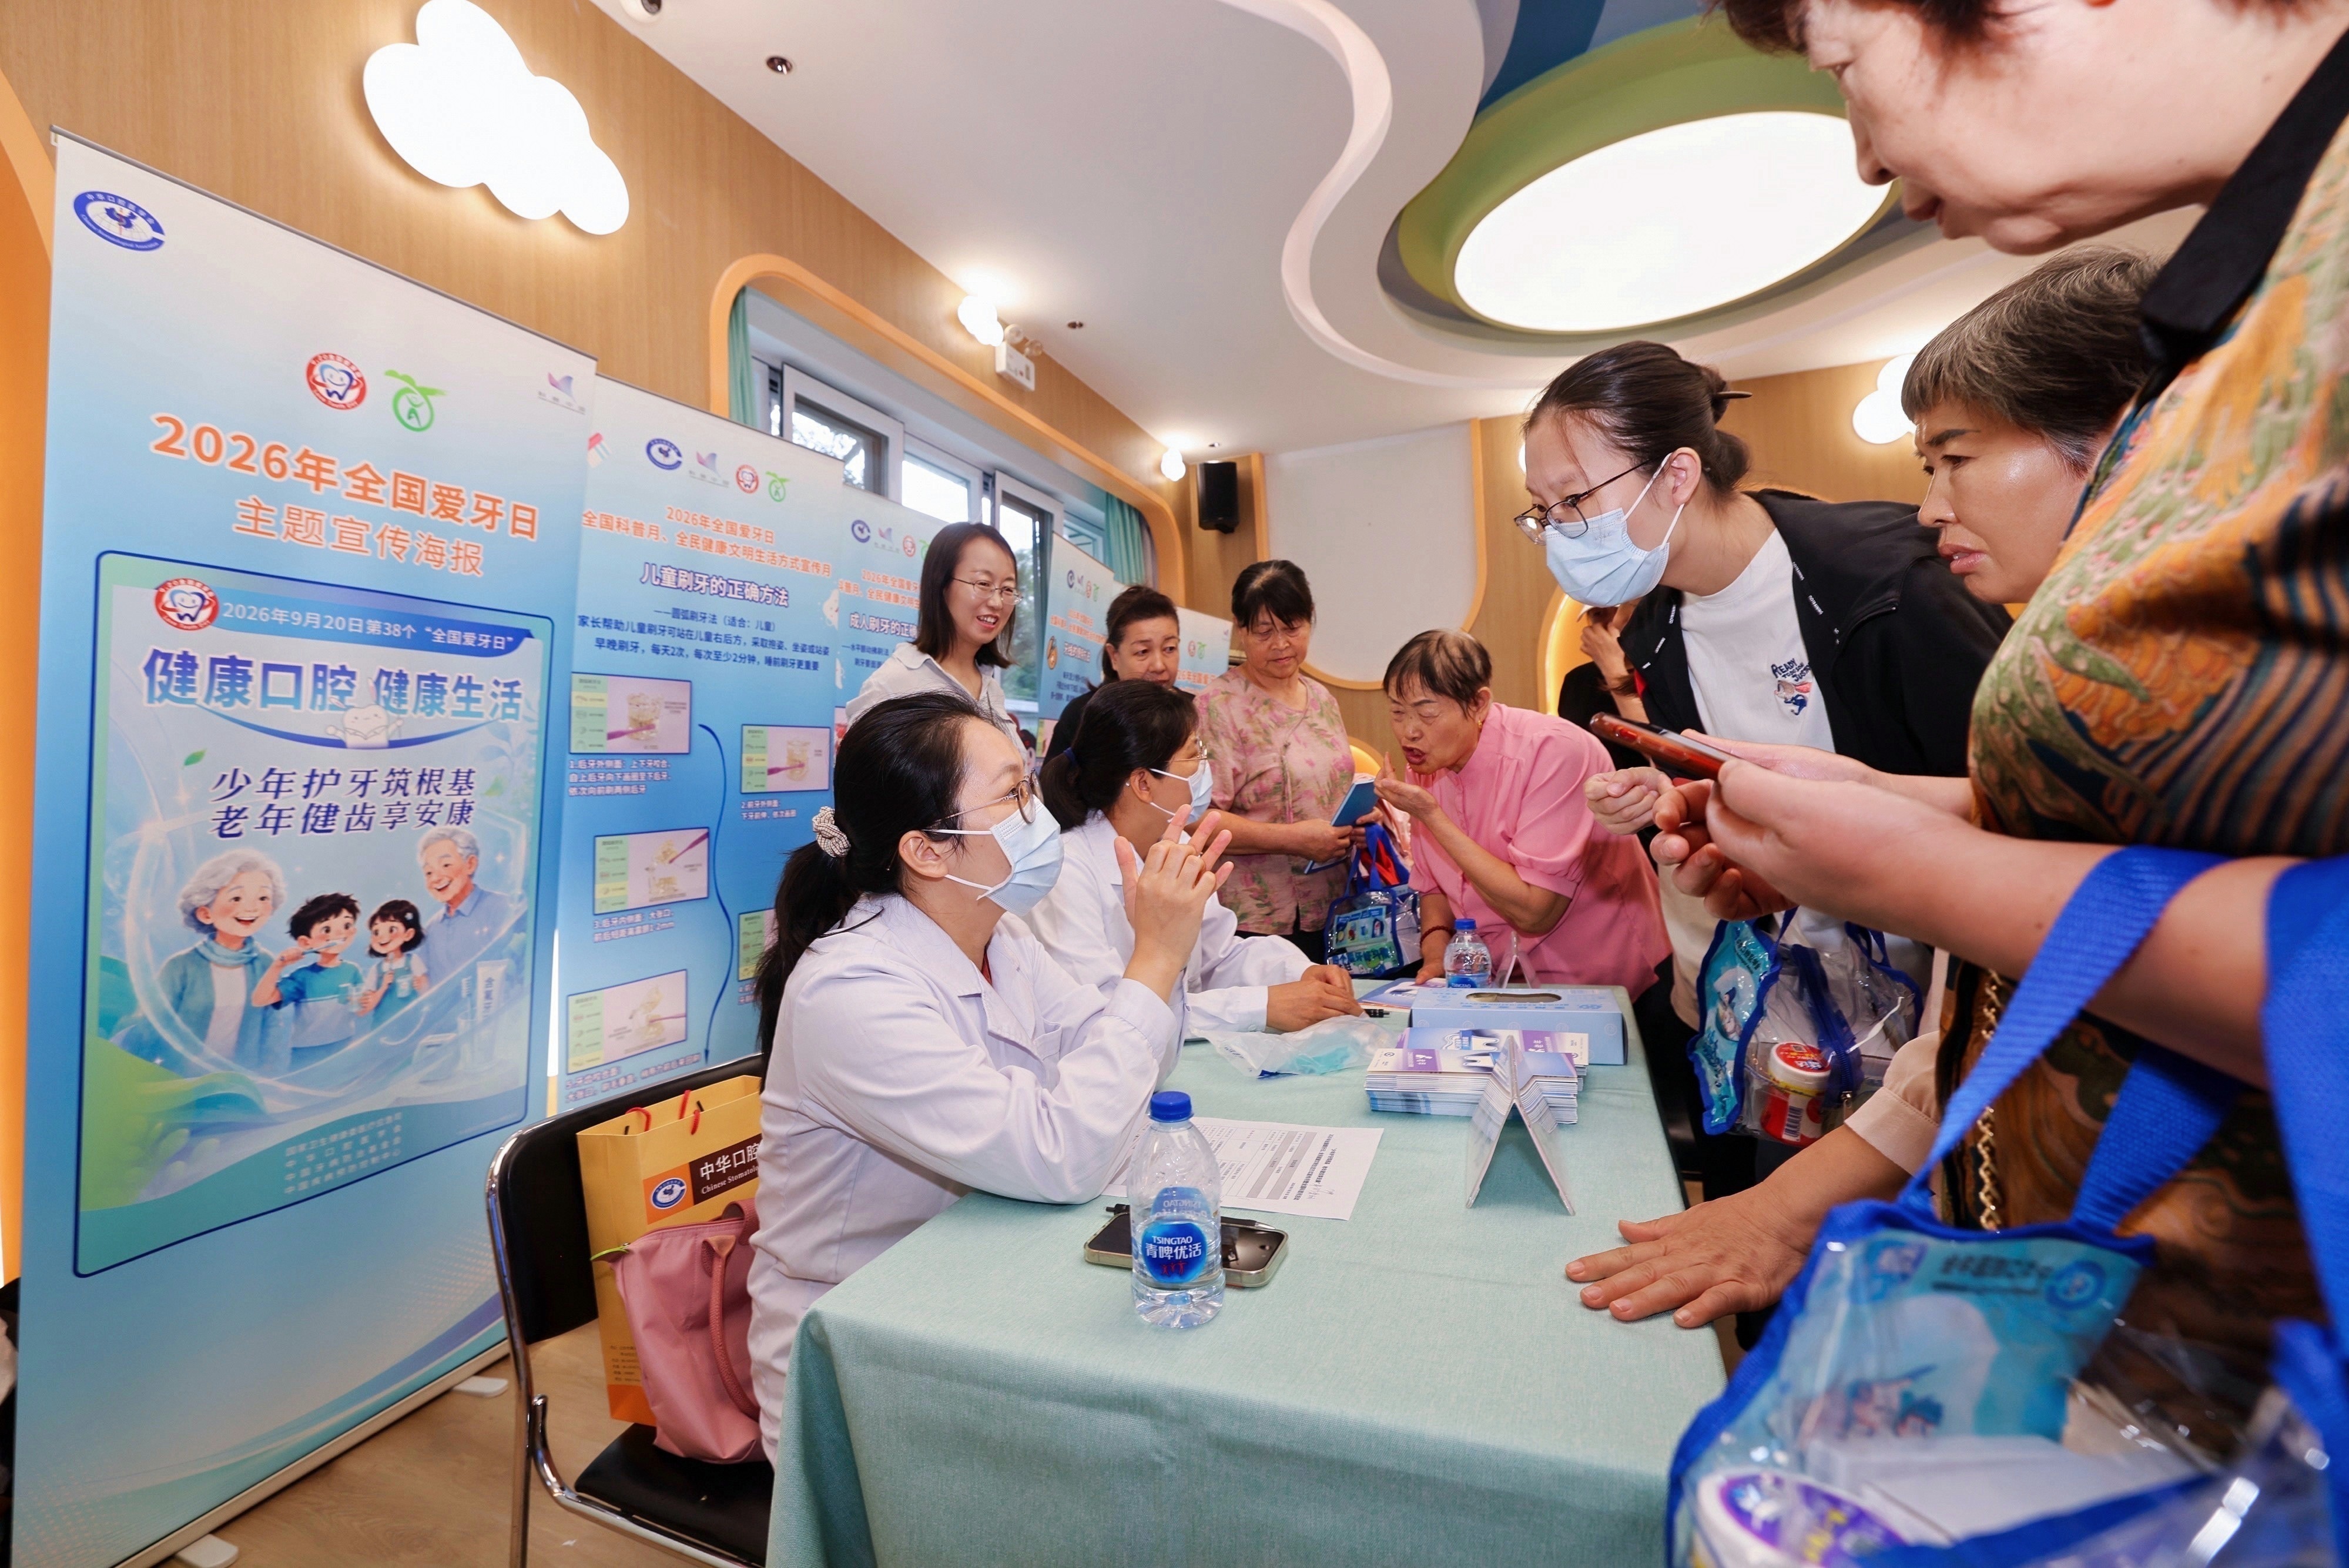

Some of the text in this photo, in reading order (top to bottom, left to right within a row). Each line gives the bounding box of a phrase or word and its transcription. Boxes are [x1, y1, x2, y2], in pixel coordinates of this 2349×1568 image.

[151, 414, 539, 540] 2026年全国爱牙日
[233, 495, 485, 577] 主题宣传海报
[582, 510, 832, 578] 全国科普月、全民健康文明生活方式宣传月
[666, 506, 775, 545] 2026年全国爱牙日
[641, 562, 789, 607] 儿童刷牙的正确方法
[143, 647, 522, 722] 健康口腔 健康生活
[1771, 658, 1797, 678] READY
[210, 767, 476, 802] 少年护牙筑根基
[210, 799, 475, 839] 老年健齿享安康
[699, 1143, 759, 1181] 中华口腔
[701, 1180, 727, 1194] Chinese
[1145, 1242, 1202, 1260] 青啤优活
[1152, 1235, 1193, 1245] TSINGTAO
